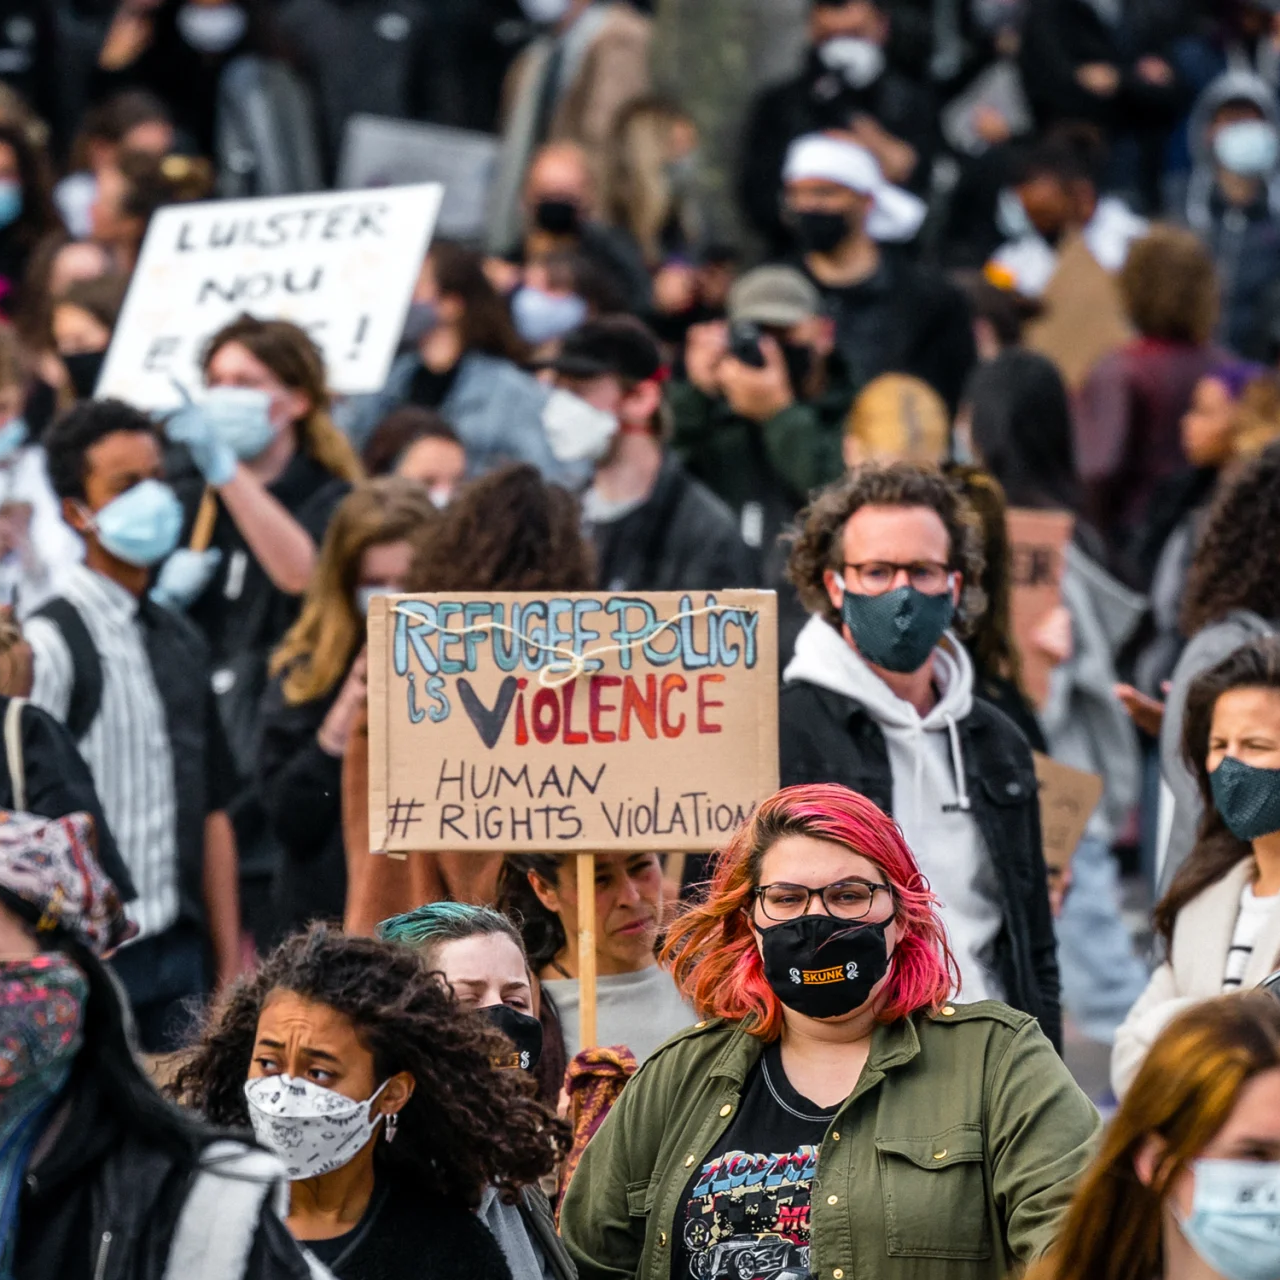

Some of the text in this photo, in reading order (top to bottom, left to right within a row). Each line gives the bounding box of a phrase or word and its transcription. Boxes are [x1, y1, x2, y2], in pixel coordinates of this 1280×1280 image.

[175, 202, 391, 251] LUISTER
[196, 264, 325, 305] NOU
[394, 598, 604, 676] REFUGEE
[435, 758, 606, 800] HUMAN
[802, 968, 845, 983] SKUNK
